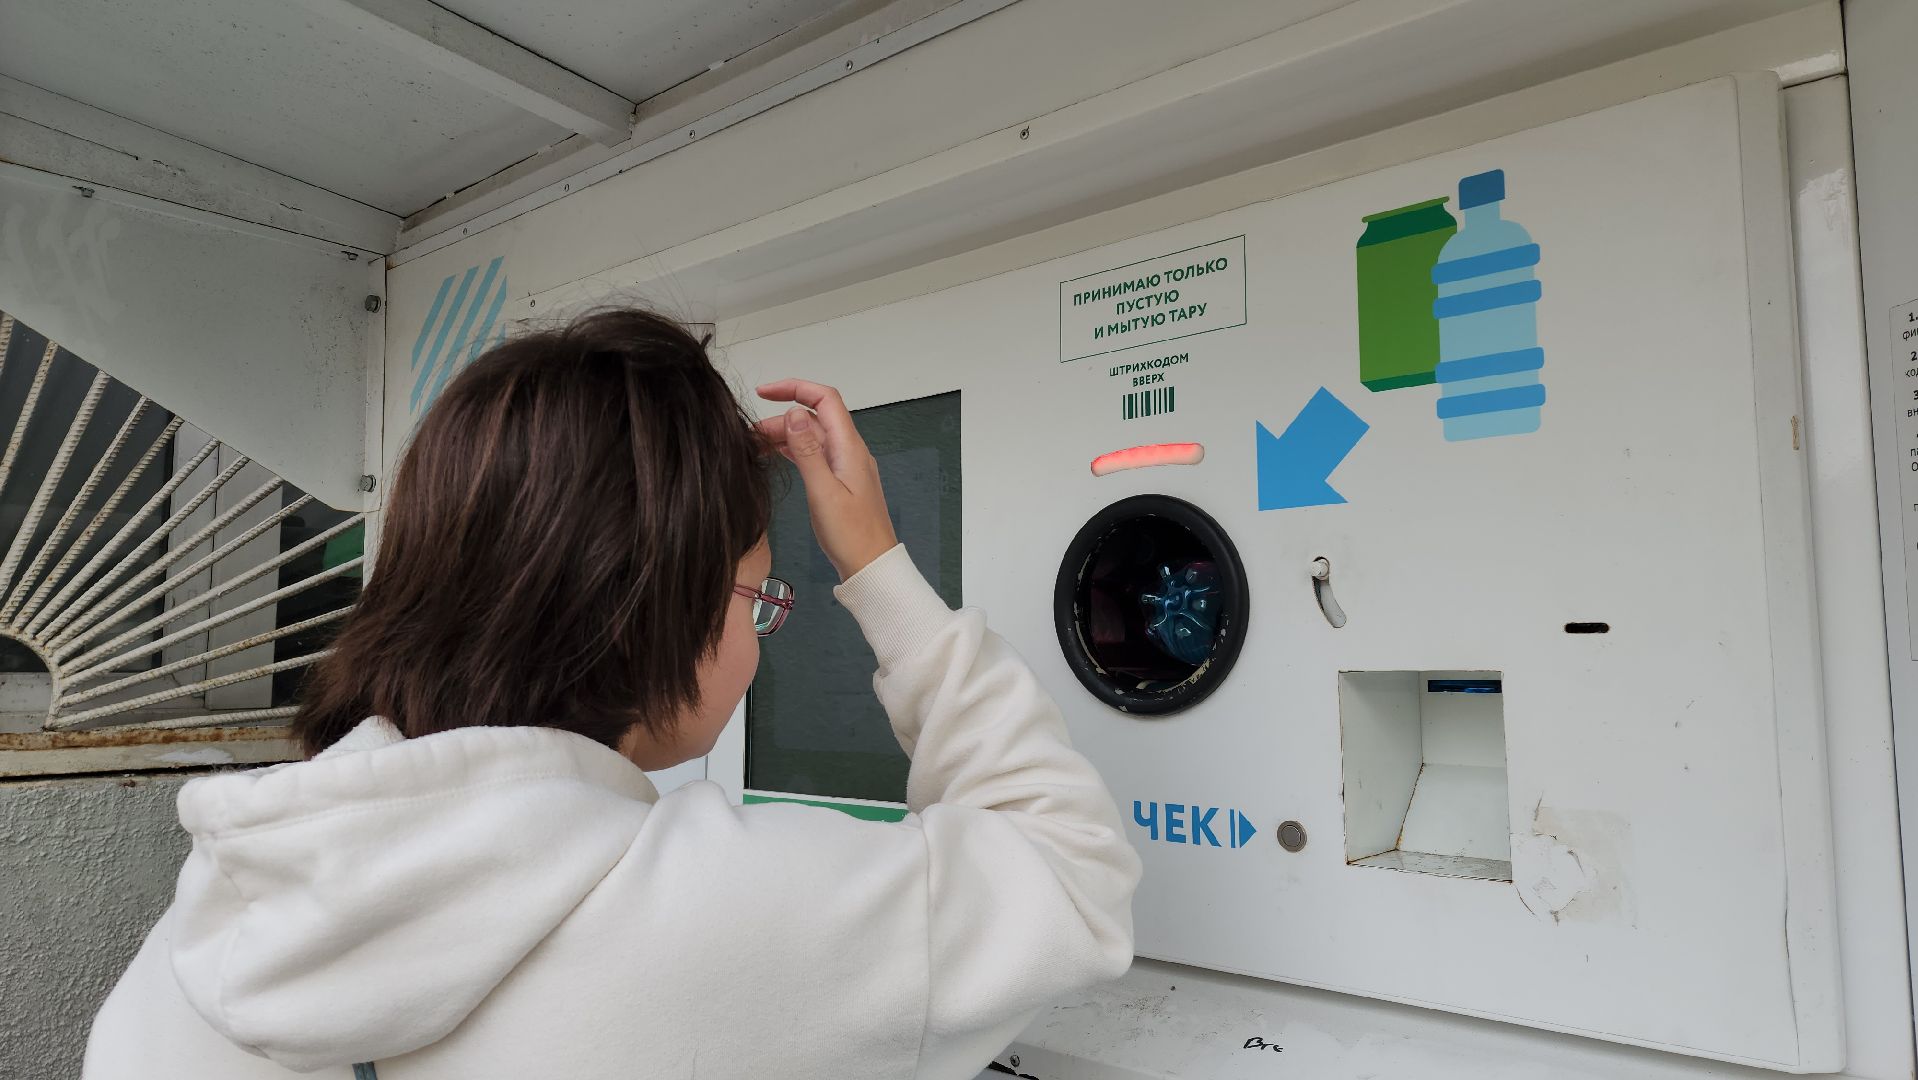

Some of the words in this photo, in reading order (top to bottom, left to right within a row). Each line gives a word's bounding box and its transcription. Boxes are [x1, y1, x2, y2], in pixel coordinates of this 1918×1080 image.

[1073, 274, 1161, 306] ПРИНИМАЮ
[1164, 257, 1228, 284] ТОЛЬКО
[1116, 289, 1179, 315] ПУСТУЮ
[1094, 326, 1104, 340] И
[1107, 312, 1166, 337] МЫТУЮ
[1169, 302, 1208, 323] ТАРУ
[1109, 352, 1189, 376] ШТРИХКОДОМ
[1132, 372, 1165, 387] ВВЕРХ
[1133, 800, 1222, 848] ЧЕК
